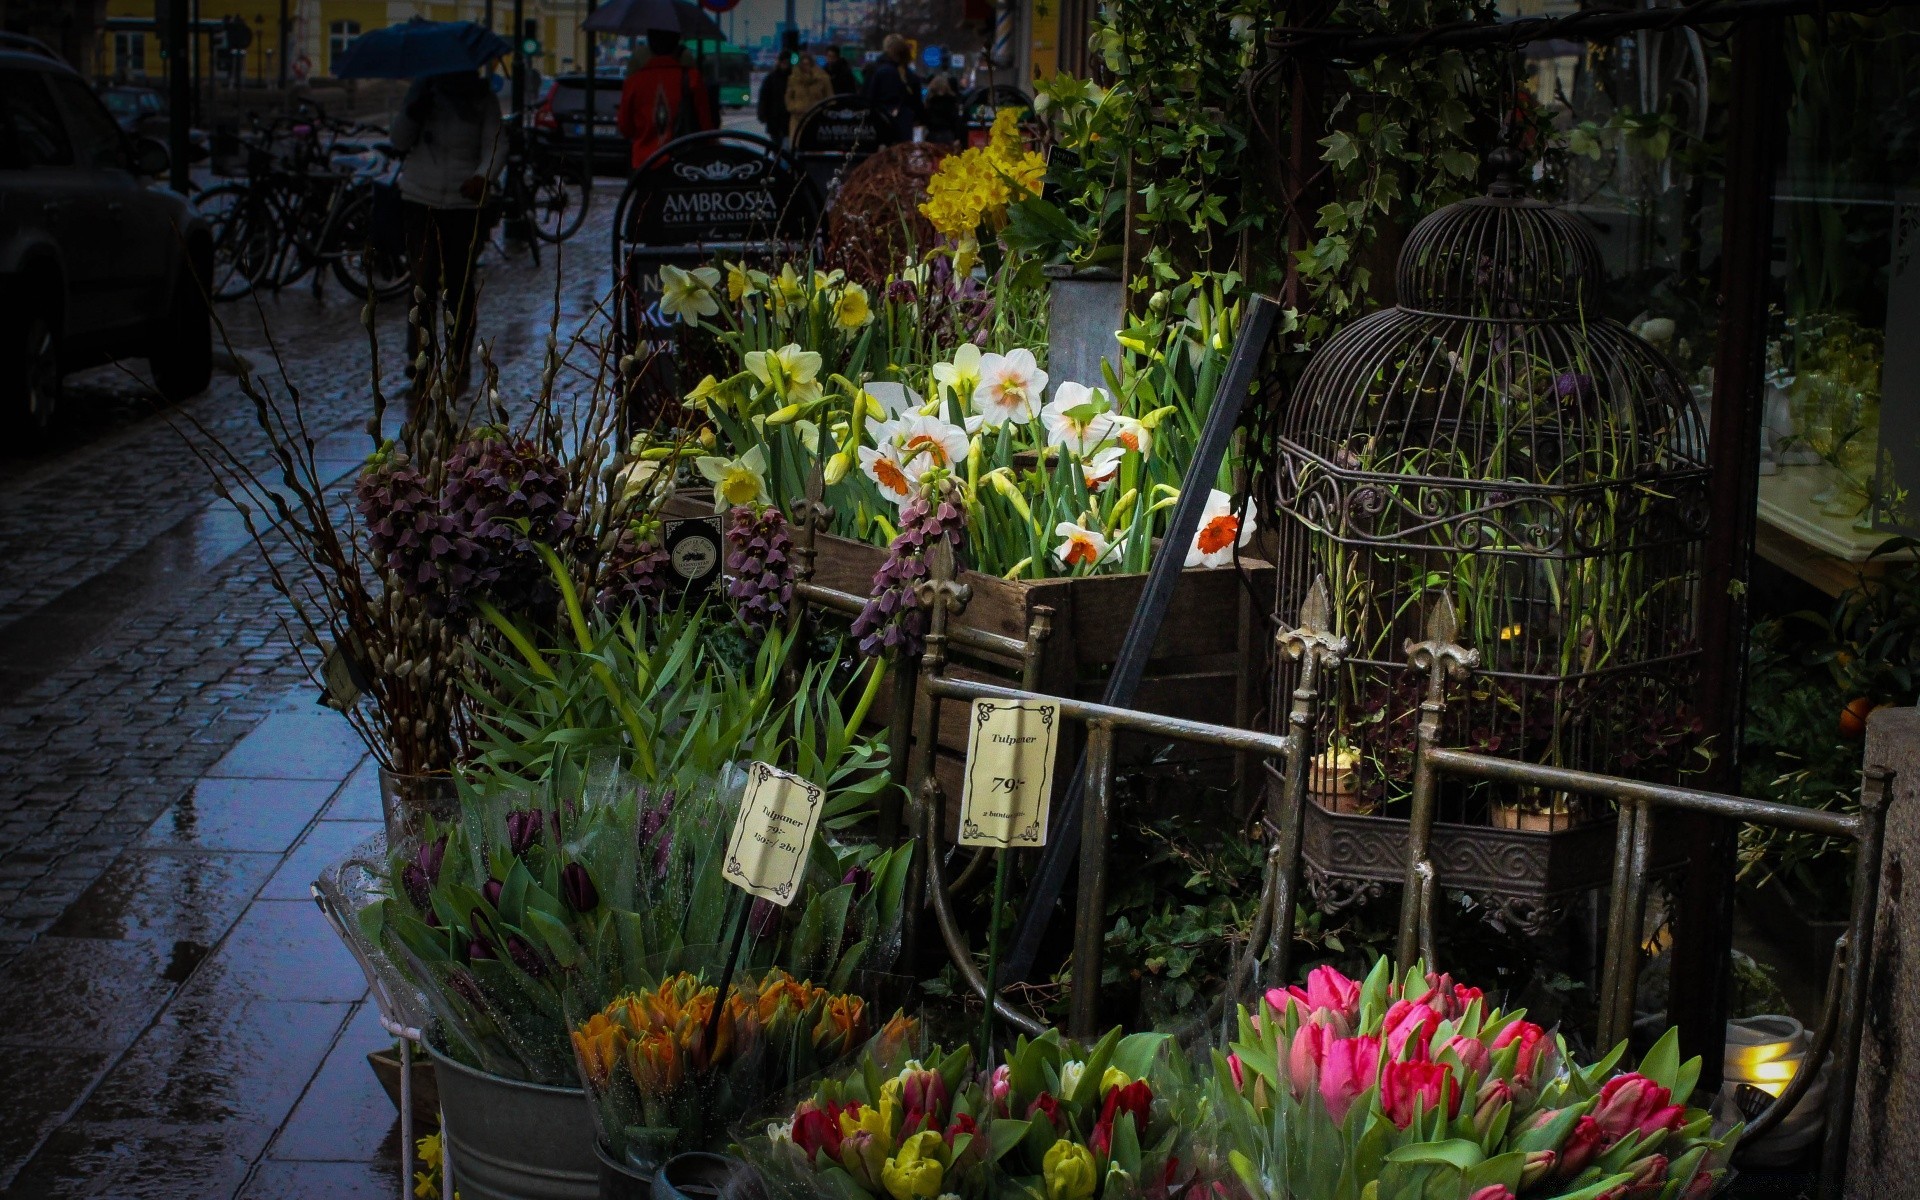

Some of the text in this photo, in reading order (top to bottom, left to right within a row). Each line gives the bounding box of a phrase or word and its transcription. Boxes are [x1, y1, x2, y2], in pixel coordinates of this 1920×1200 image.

[992, 733, 1037, 746] Tulpaner
[991, 777, 1026, 794] 79:-
[762, 805, 804, 828] Tulpaner
[766, 825, 786, 834] 79:-
